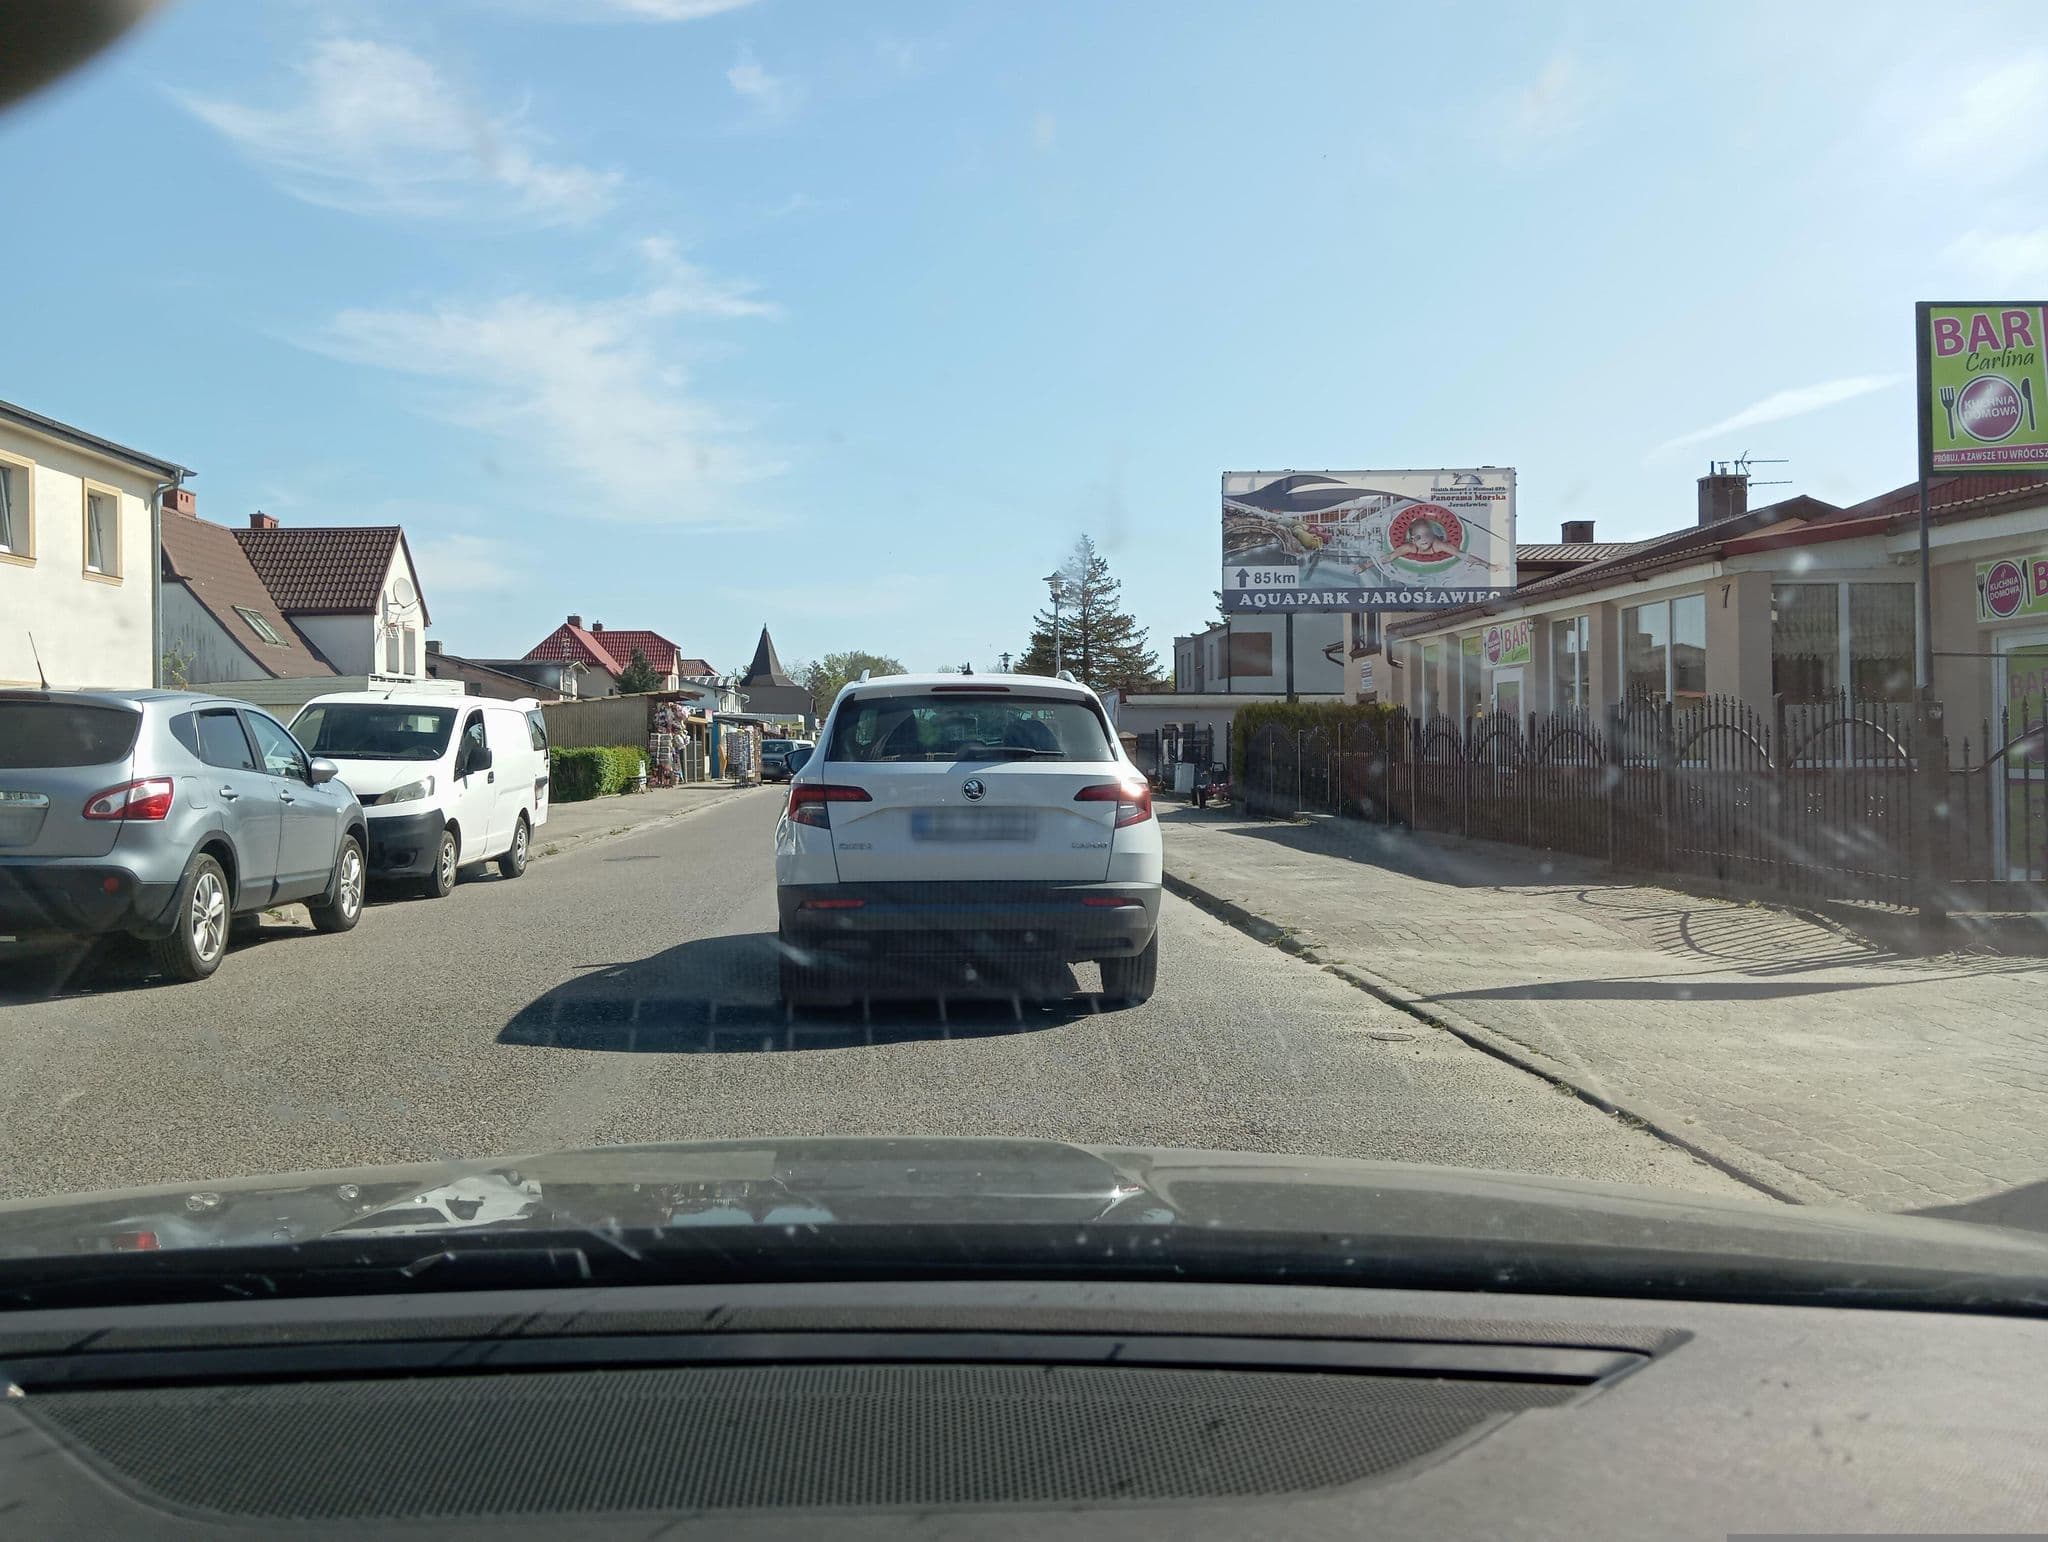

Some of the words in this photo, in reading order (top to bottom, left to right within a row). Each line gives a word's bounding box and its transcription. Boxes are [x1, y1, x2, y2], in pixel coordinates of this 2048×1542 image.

[1933, 310, 2035, 357] BAR
[1966, 346, 2034, 372] Carlina
[1960, 453, 1966, 461] A
[1966, 451, 1996, 461] ZAWSZE
[1997, 450, 2008, 460] TU
[1474, 493, 1506, 501] Morska
[1989, 576, 2019, 592] KUCHNIA
[1239, 592, 1350, 608] AQUAPARK
[1989, 585, 2021, 601] DOMOWA
[1504, 620, 1528, 652] BAR
